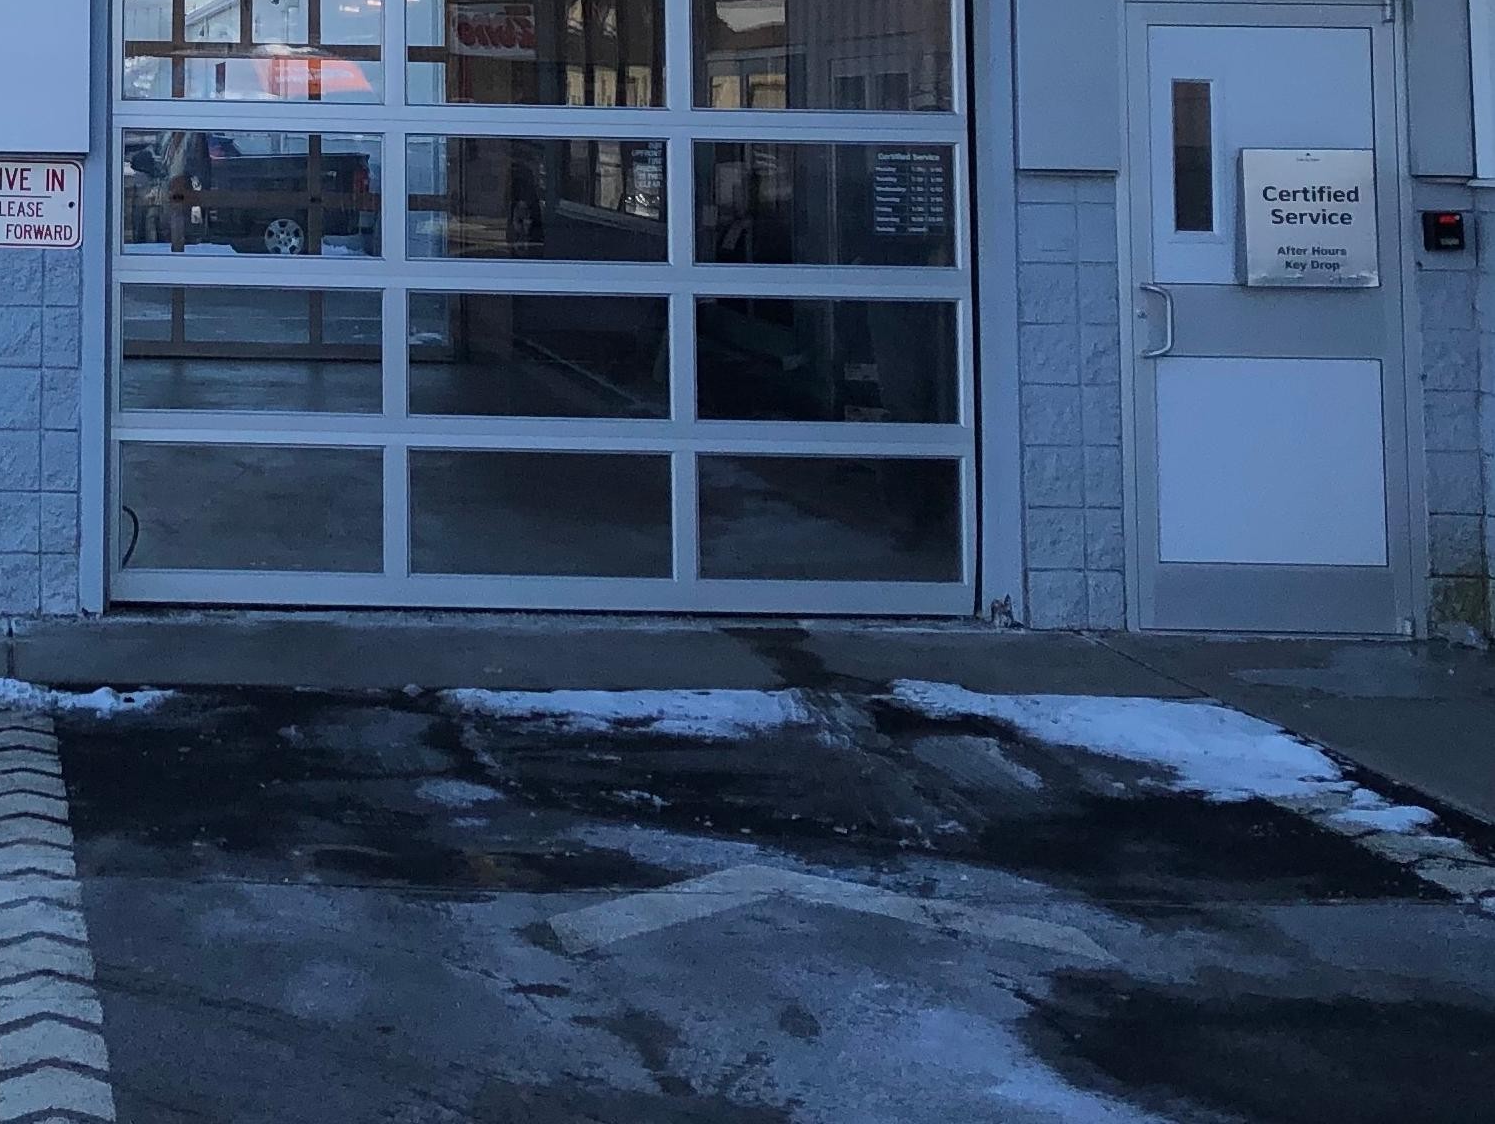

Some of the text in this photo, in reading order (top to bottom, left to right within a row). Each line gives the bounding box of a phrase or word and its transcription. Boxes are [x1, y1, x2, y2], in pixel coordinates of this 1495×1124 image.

[46, 168, 66, 192] IN
[1262, 185, 1360, 203] Certified
[1271, 208, 1353, 225] Service
[6, 223, 73, 241] FORWARD
[1277, 246, 1347, 256] After Hours
[1285, 260, 1341, 271] Key Drop
